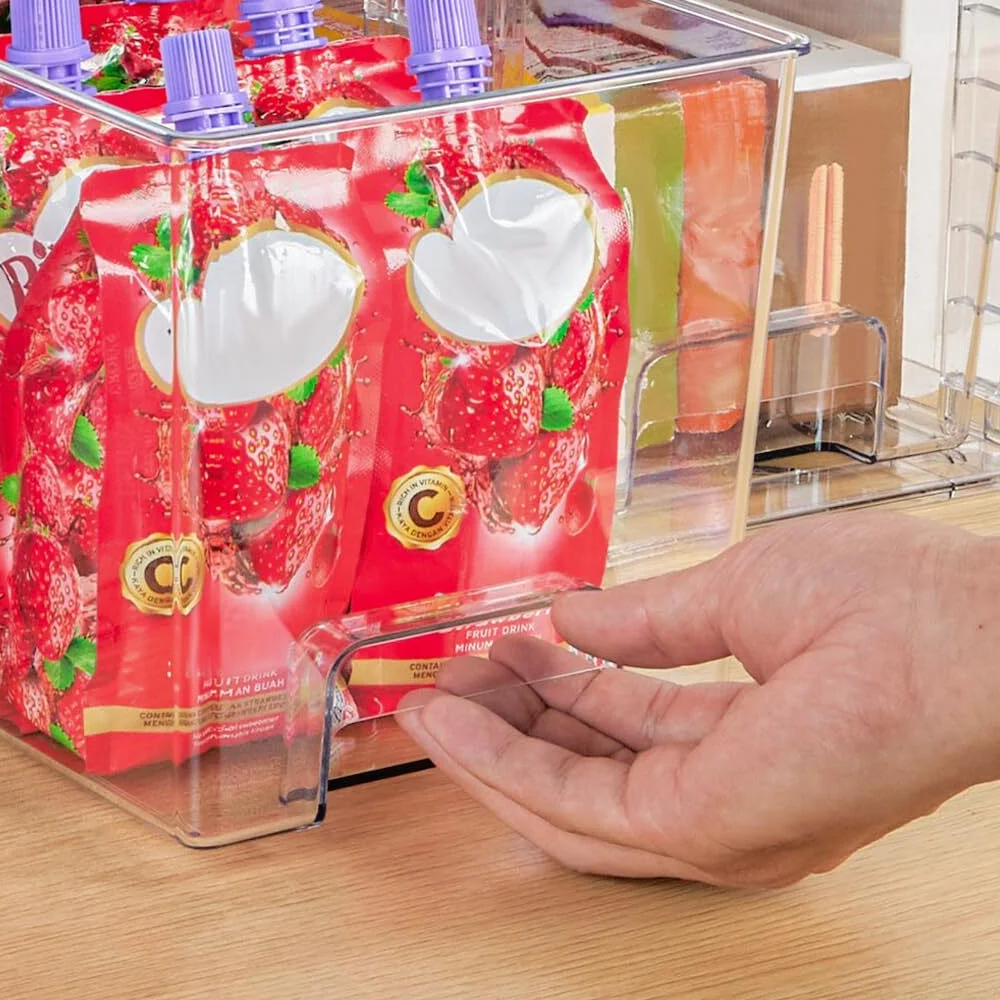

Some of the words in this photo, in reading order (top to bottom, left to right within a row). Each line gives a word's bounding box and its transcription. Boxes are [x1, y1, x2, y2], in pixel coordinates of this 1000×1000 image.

[408, 489, 445, 528] C
[466, 627, 499, 640] FRUIT
[502, 623, 536, 636] DRINK
[455, 640, 494, 653] MINUM
[254, 678, 285, 692] BUAH
